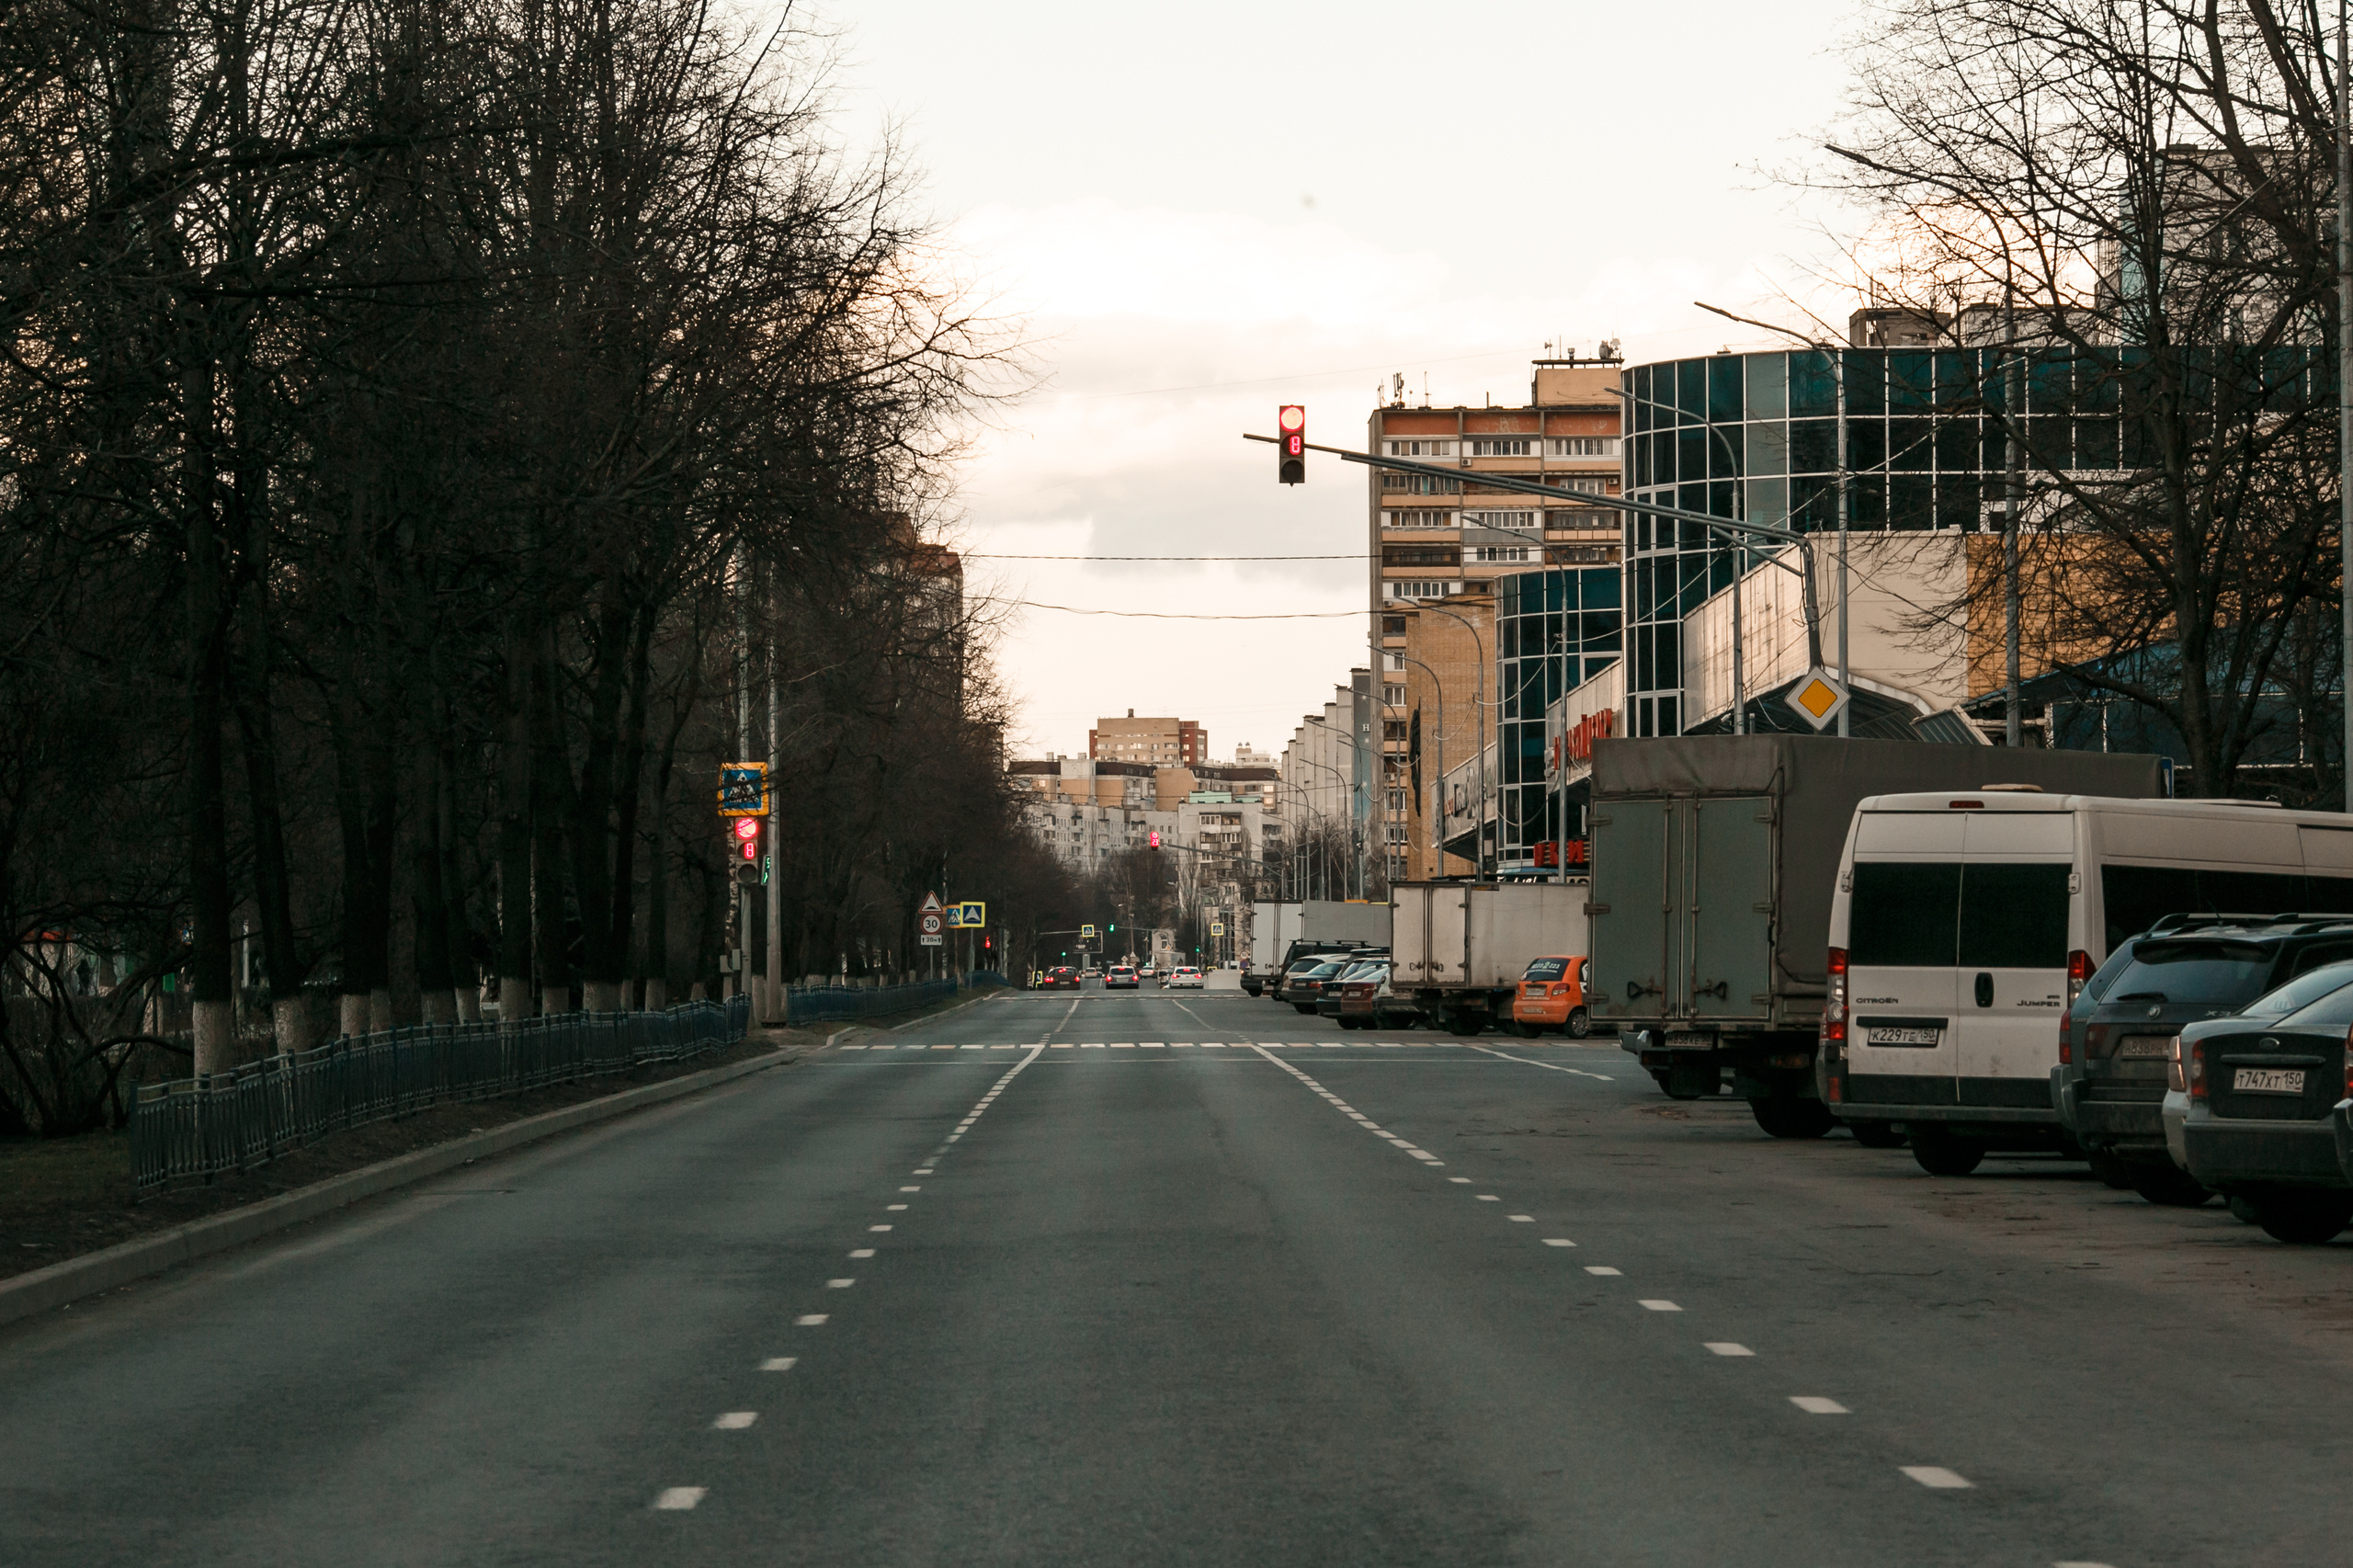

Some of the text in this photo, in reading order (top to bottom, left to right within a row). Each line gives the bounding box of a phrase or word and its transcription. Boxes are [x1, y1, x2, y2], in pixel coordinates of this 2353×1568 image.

[1290, 436, 1301, 454] 8
[745, 843, 755, 858] 8
[925, 919, 938, 929] 30
[2238, 1071, 2302, 1088] Т747ХТ 150
